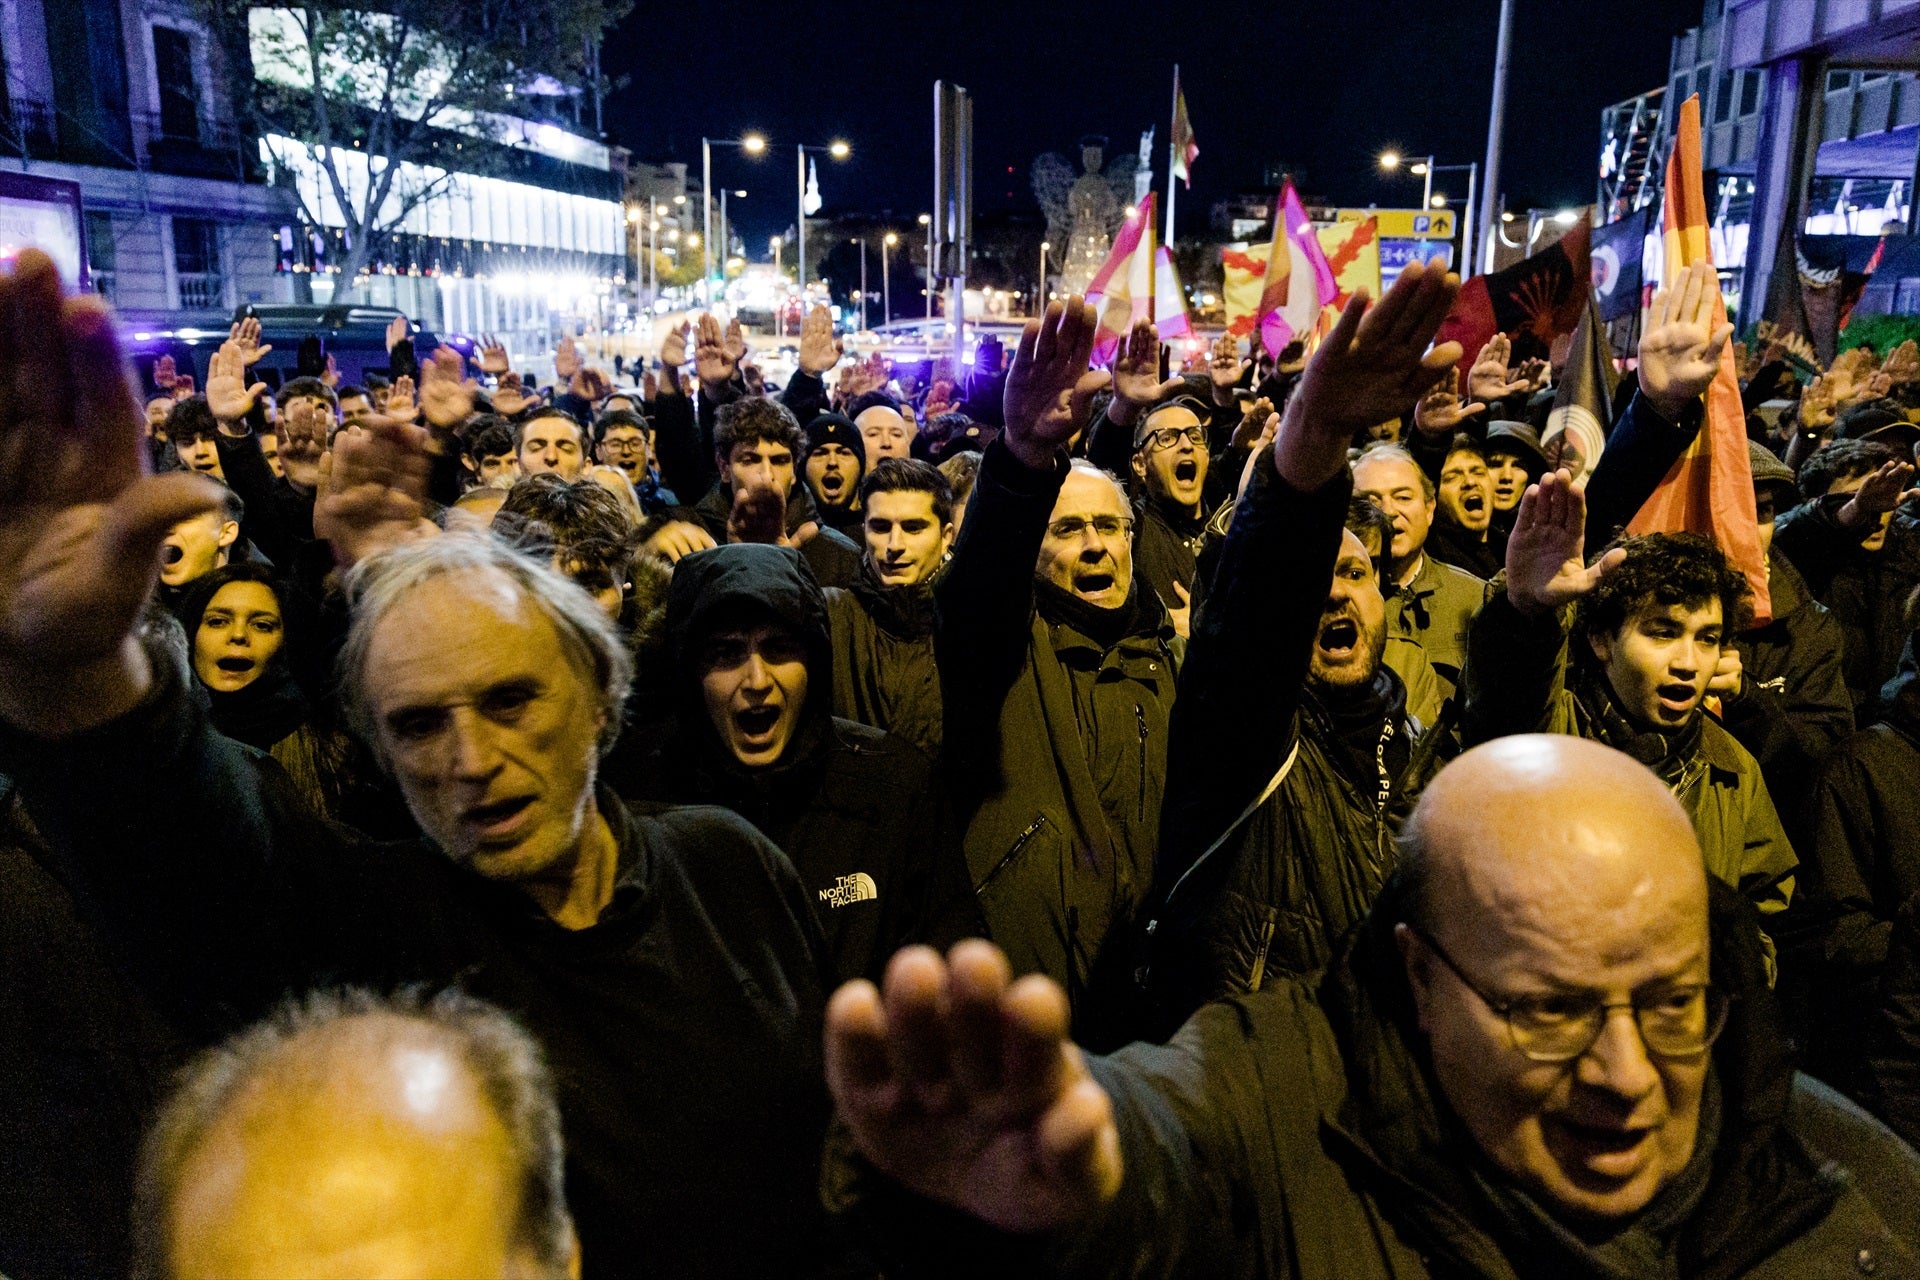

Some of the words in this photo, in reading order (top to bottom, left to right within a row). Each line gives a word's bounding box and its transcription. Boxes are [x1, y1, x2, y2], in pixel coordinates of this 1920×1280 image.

[835, 873, 857, 888] THE
[819, 883, 857, 901] NORTH
[830, 893, 858, 909] FACE
